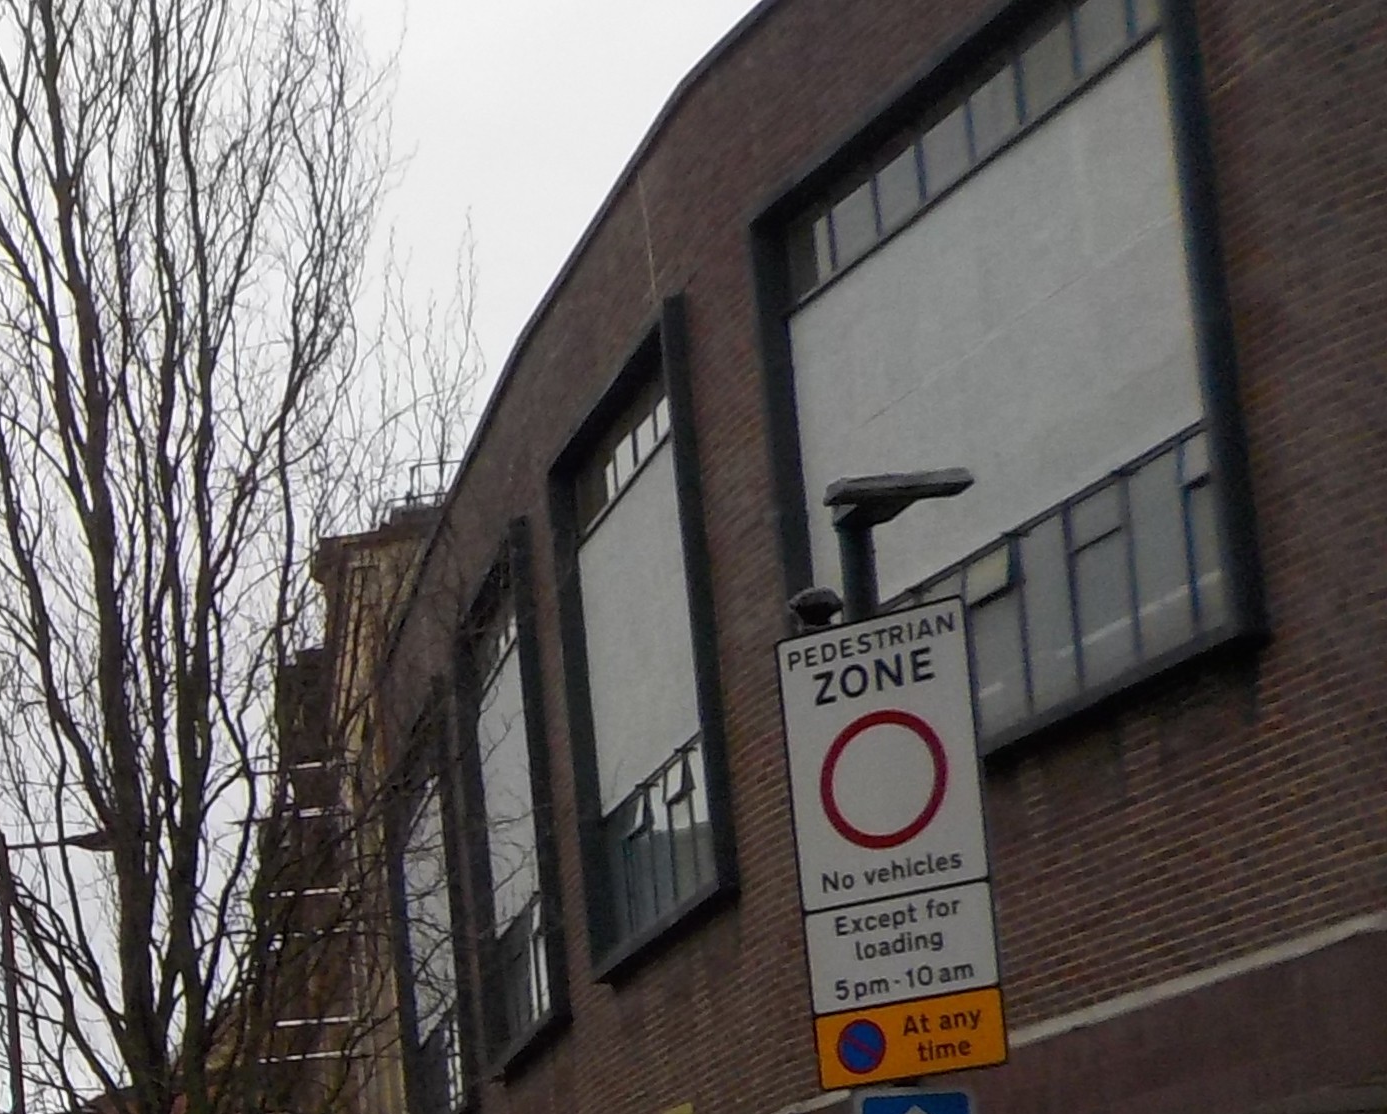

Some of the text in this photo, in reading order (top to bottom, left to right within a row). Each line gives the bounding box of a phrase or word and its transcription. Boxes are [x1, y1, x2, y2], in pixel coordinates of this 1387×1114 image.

[787, 612, 956, 672] PEDESTRIAN
[812, 646, 936, 706] ZONE
[821, 853, 963, 894] No vehicles
[834, 898, 961, 938] Except for
[854, 931, 944, 961] loading
[902, 1008, 982, 1037] At any
[916, 1039, 972, 1062] time
